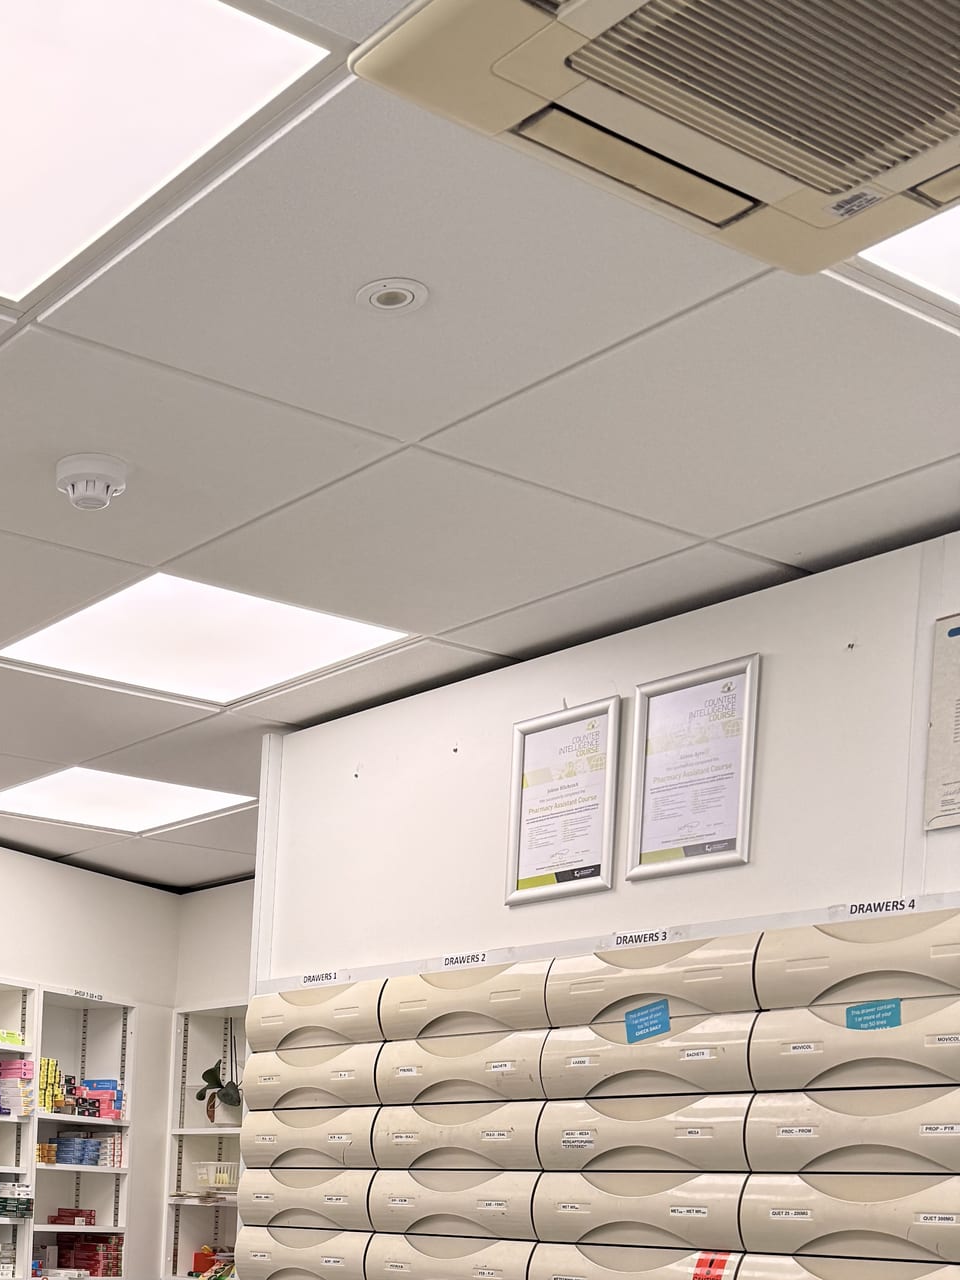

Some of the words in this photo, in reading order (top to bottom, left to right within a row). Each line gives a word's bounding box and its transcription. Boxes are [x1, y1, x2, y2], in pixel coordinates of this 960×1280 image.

[704, 694, 737, 708] COUNTER
[689, 704, 736, 719] INTELLIGENCE
[709, 711, 736, 723] COURSE
[572, 731, 600, 744] COUNTER
[559, 740, 600, 755] INTELLIGENCE
[576, 748, 599, 758] COURSE
[653, 773, 681, 785] Pharmacy
[682, 767, 710, 780] Assistant
[710, 763, 733, 774] Course
[528, 806, 553, 816] Pharmacy
[554, 799, 578, 810] Assistant
[578, 794, 597, 804] Course
[850, 900, 905, 914] DRAWERS
[908, 899, 916, 909] 4
[616, 932, 659, 945] DRAWERS
[661, 931, 667, 941] 3
[444, 955, 480, 966] DRAWERS
[481, 953, 486, 962] 2
[303, 973, 332, 983] DRAWERS
[333, 972, 337, 981] 1
[877, 1003, 896, 1012] contains
[635, 1028, 648, 1036] CHECK
